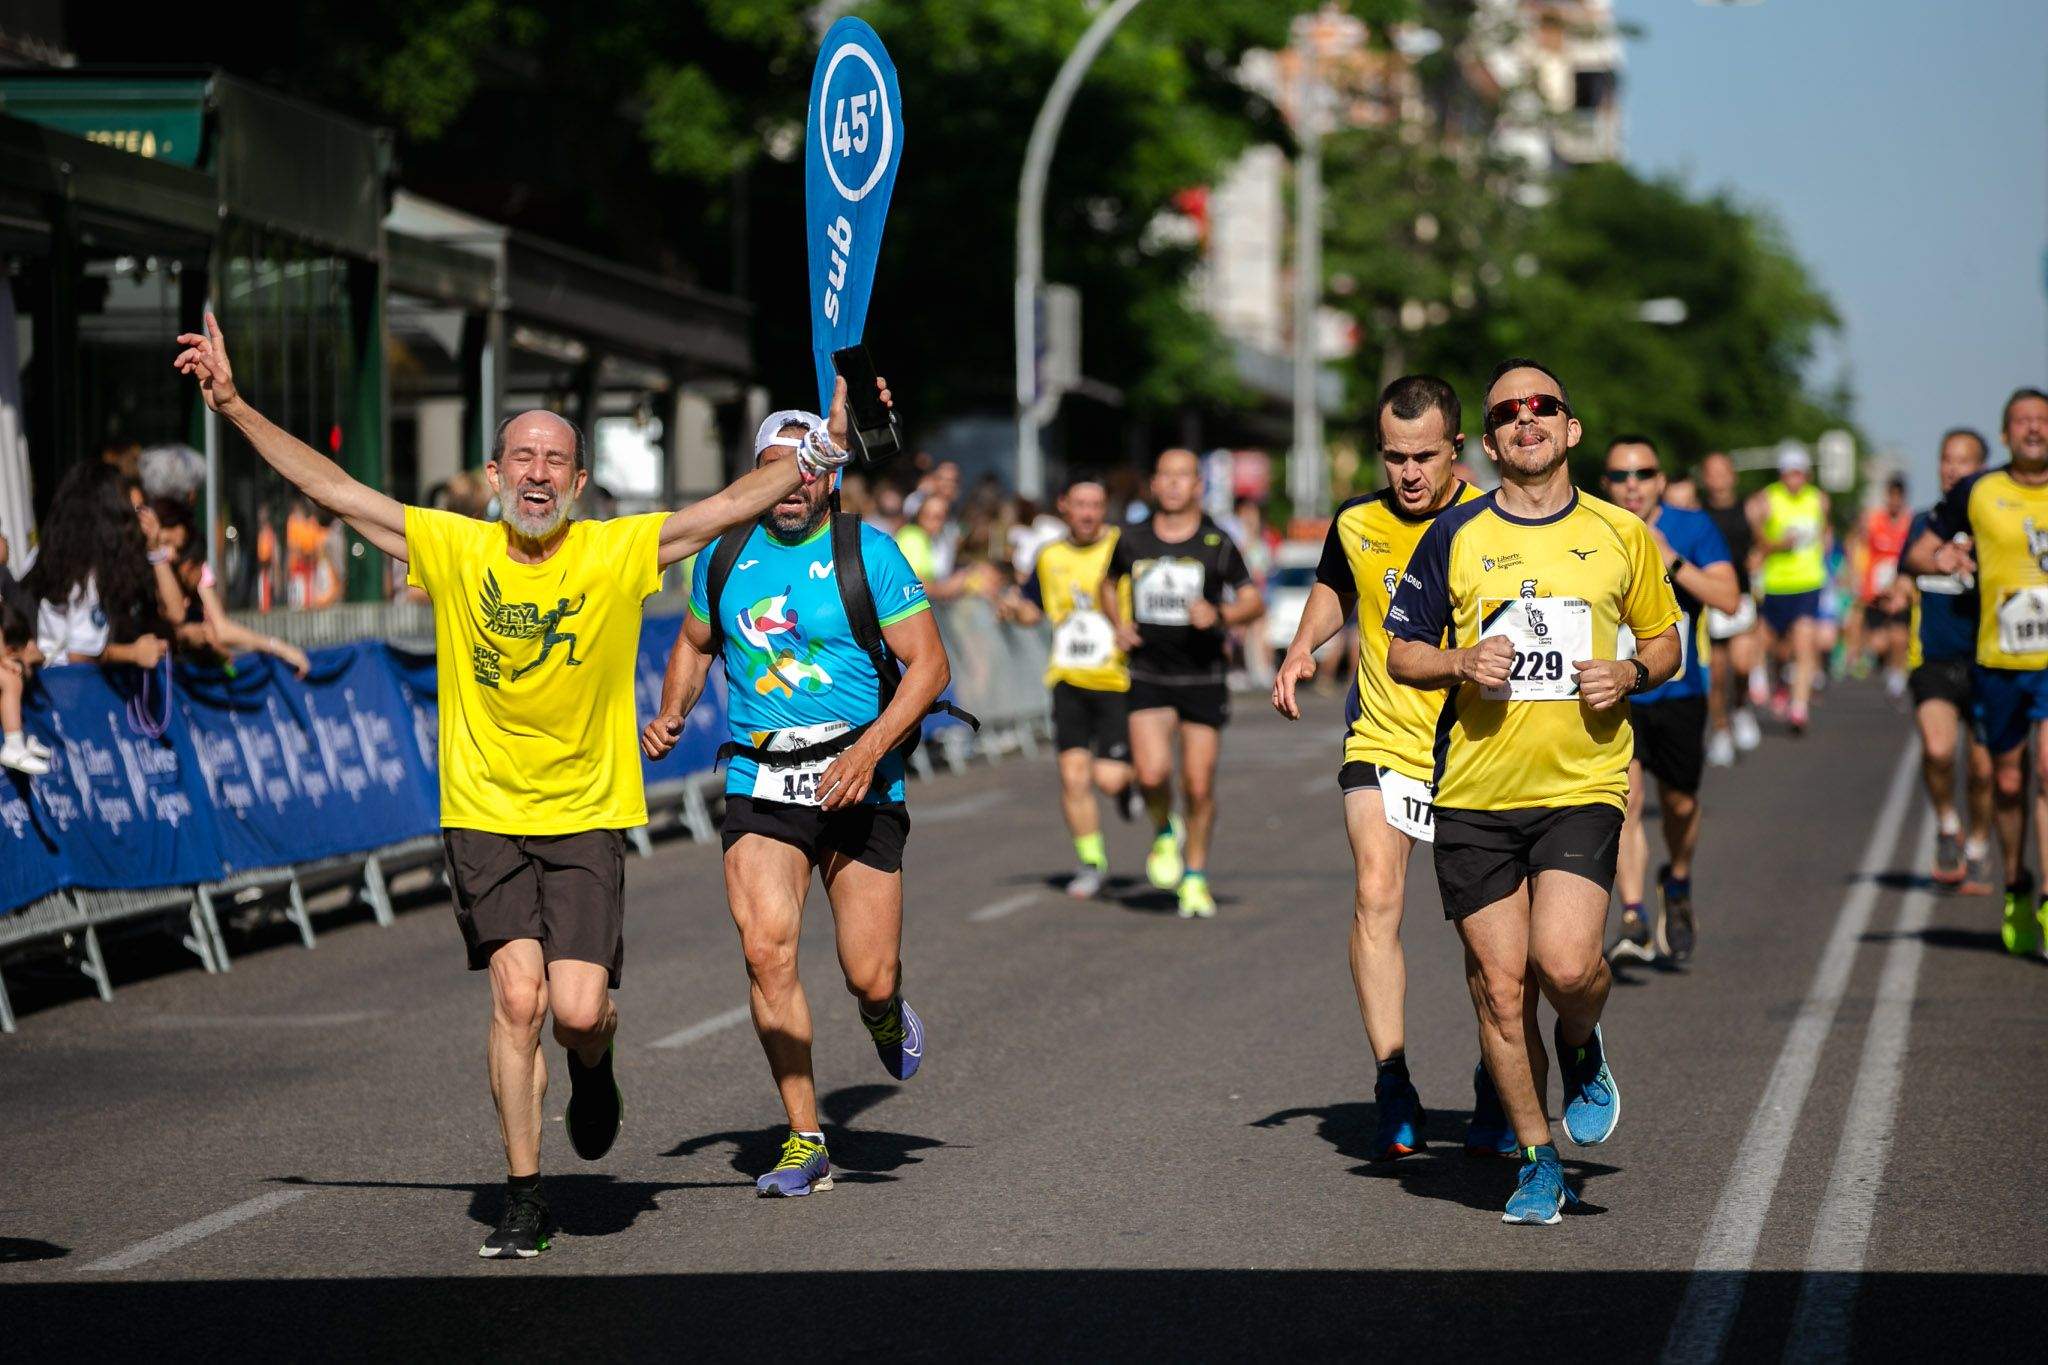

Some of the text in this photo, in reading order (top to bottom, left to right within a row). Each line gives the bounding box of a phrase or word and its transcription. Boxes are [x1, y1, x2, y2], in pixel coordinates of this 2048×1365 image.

[832, 89, 877, 158] 45'
[824, 215, 852, 328] sub
[1510, 650, 1563, 681] 229
